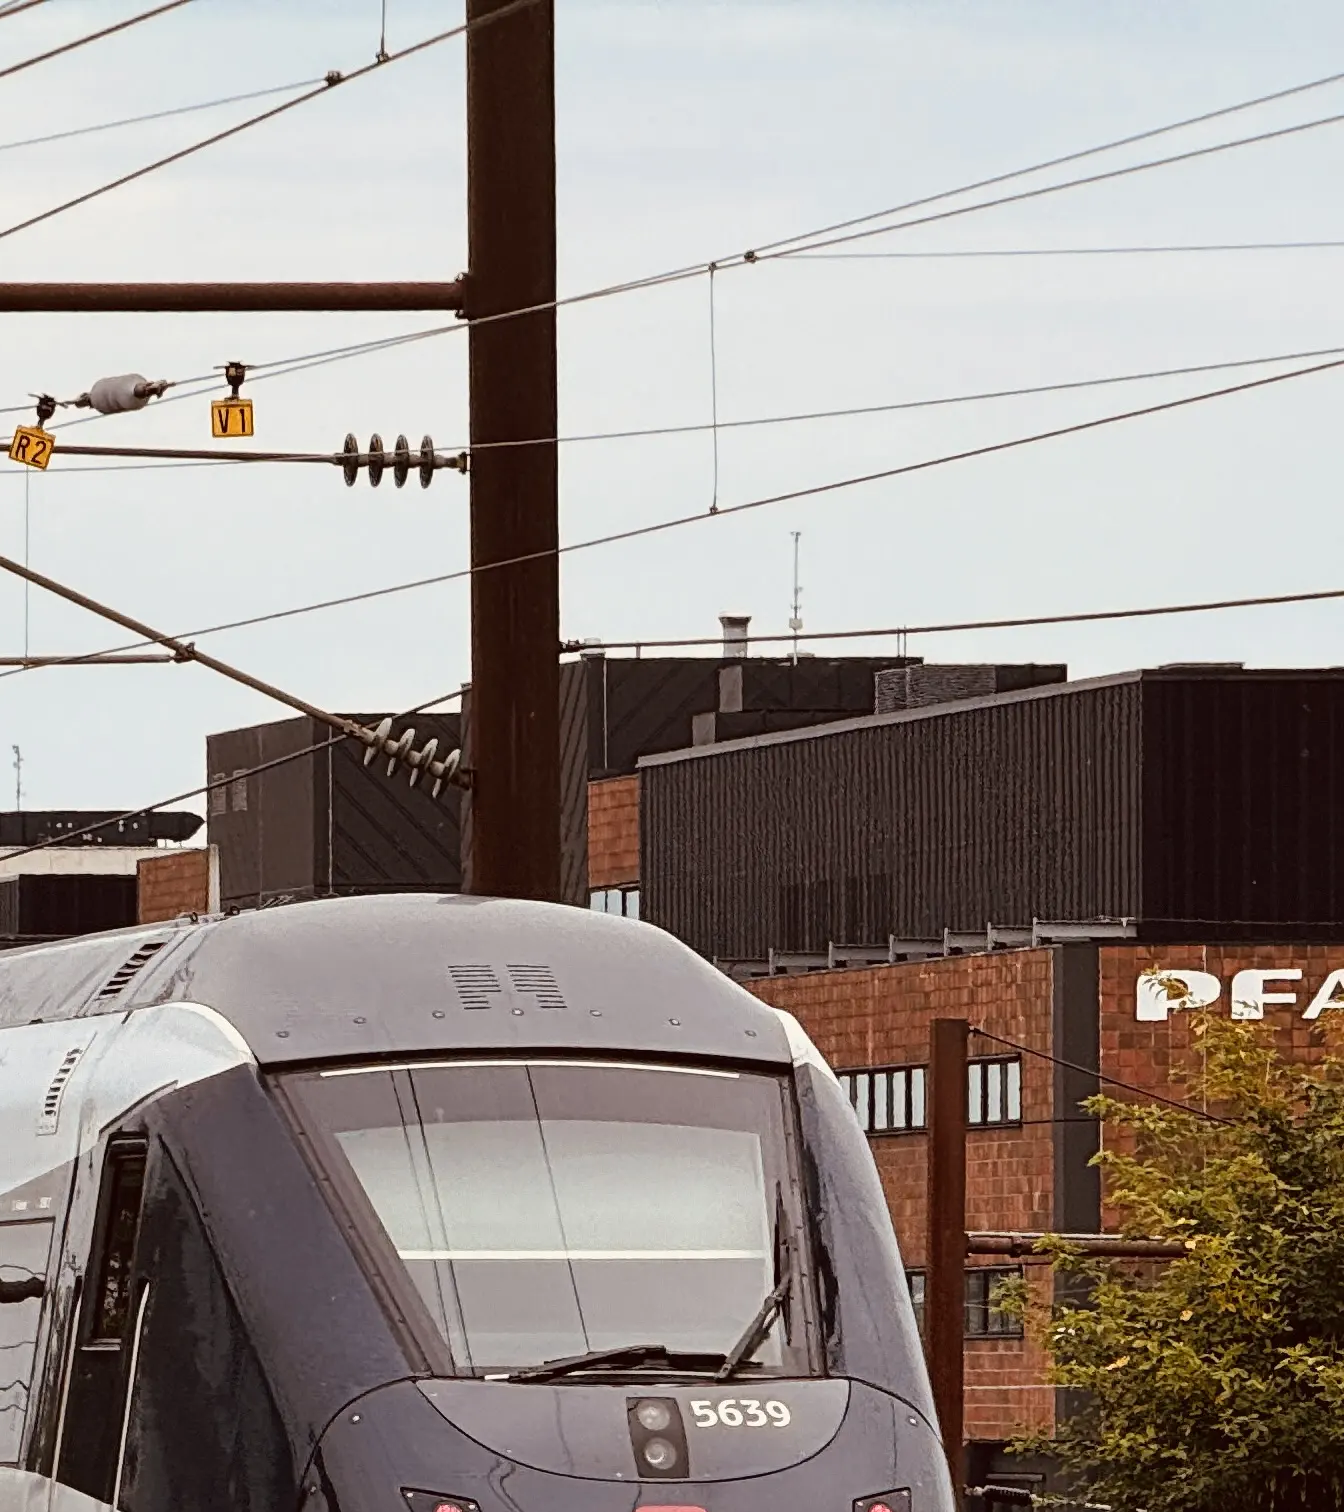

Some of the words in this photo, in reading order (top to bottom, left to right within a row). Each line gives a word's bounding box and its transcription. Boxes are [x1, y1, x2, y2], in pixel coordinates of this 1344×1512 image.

[218, 408, 245, 433] V1
[15, 435, 46, 464] R2
[690, 1400, 791, 1427] 5639
